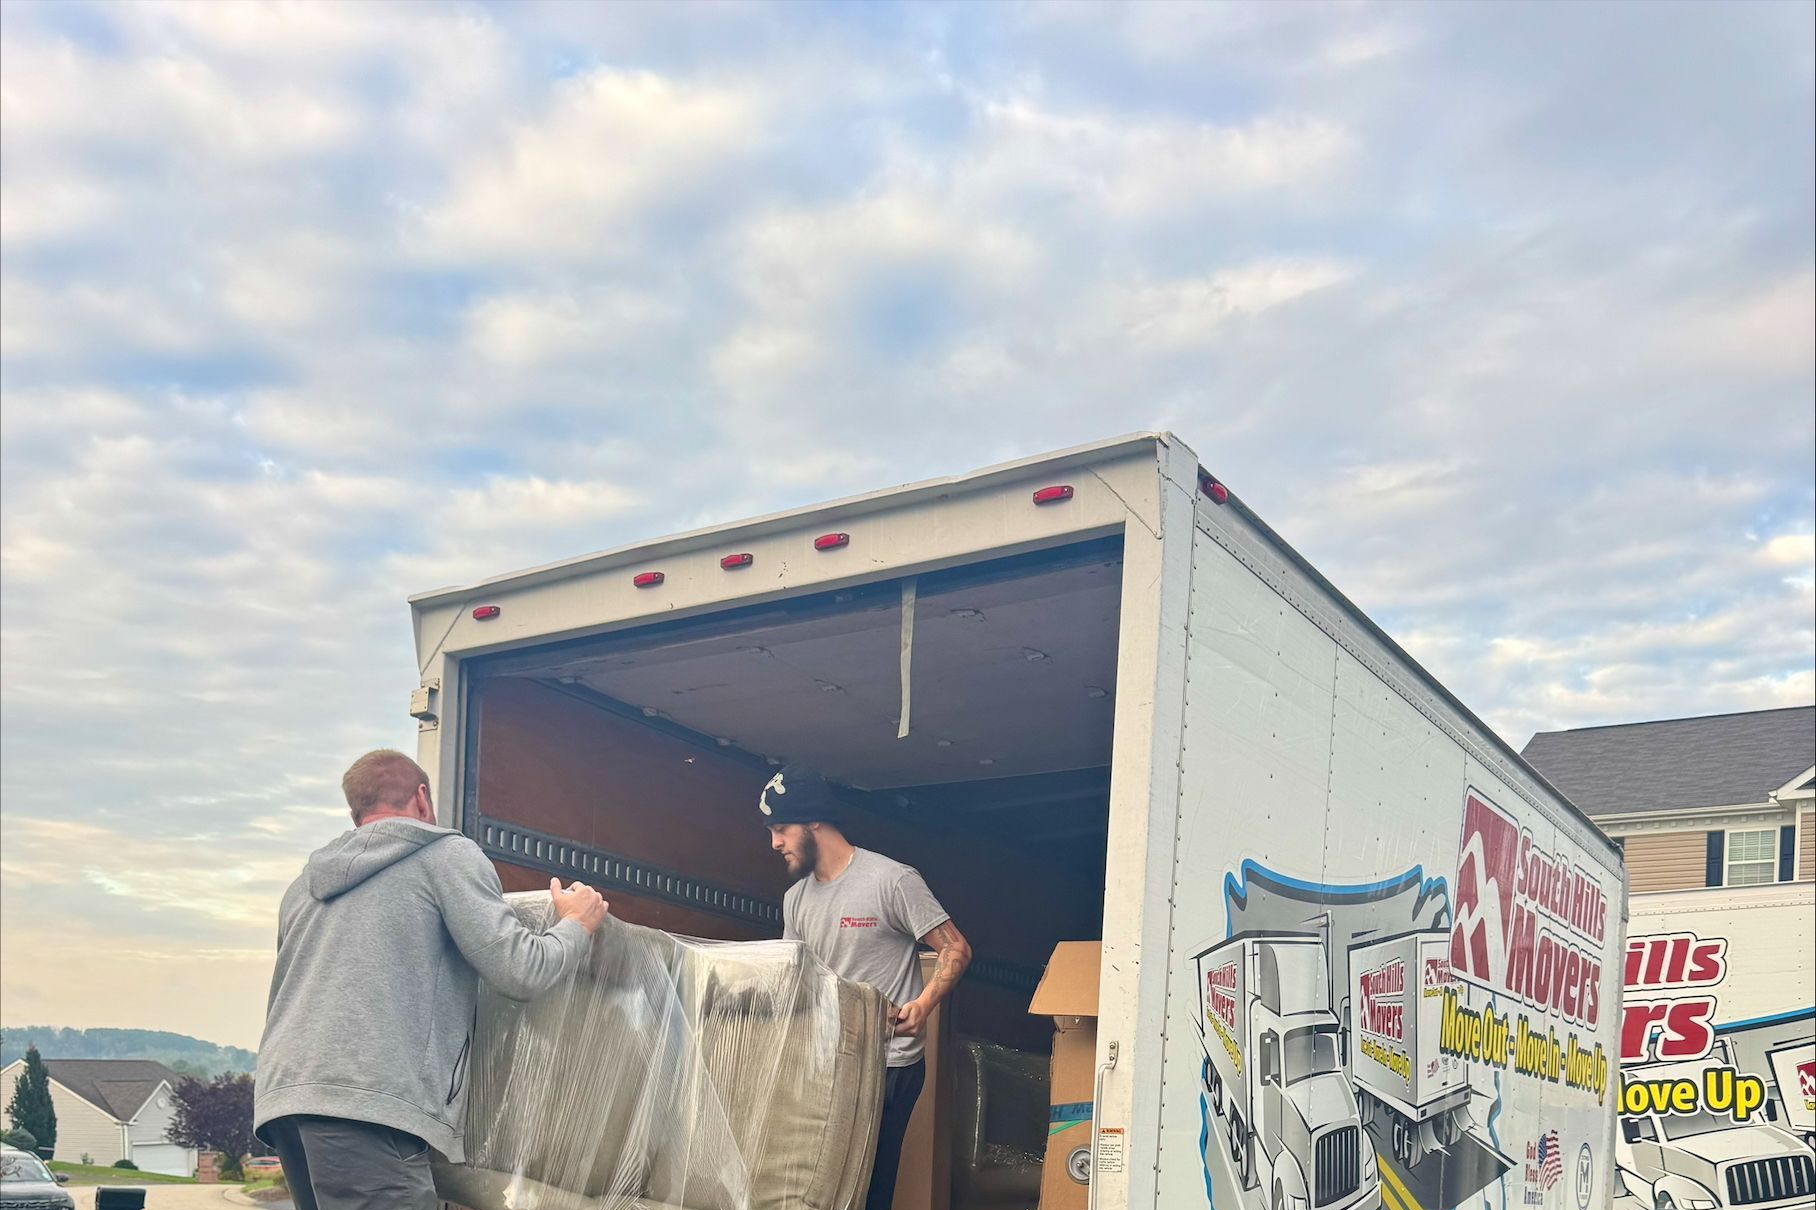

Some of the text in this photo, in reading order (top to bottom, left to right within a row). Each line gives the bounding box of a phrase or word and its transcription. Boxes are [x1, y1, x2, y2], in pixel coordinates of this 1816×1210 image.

[1516, 833, 1606, 942] South Hills
[1506, 903, 1601, 1026] Movers
[1370, 1000, 1403, 1041] Movers
[1441, 987, 1481, 1062] Move
[1482, 1001, 1508, 1070] Out
[1515, 1014, 1548, 1080] Move
[1548, 1025, 1560, 1083] In
[1566, 1032, 1593, 1092] Move
[1593, 1042, 1607, 1106] Up
[1704, 1068, 1764, 1120] Up
[1523, 1186, 1543, 1206] America
